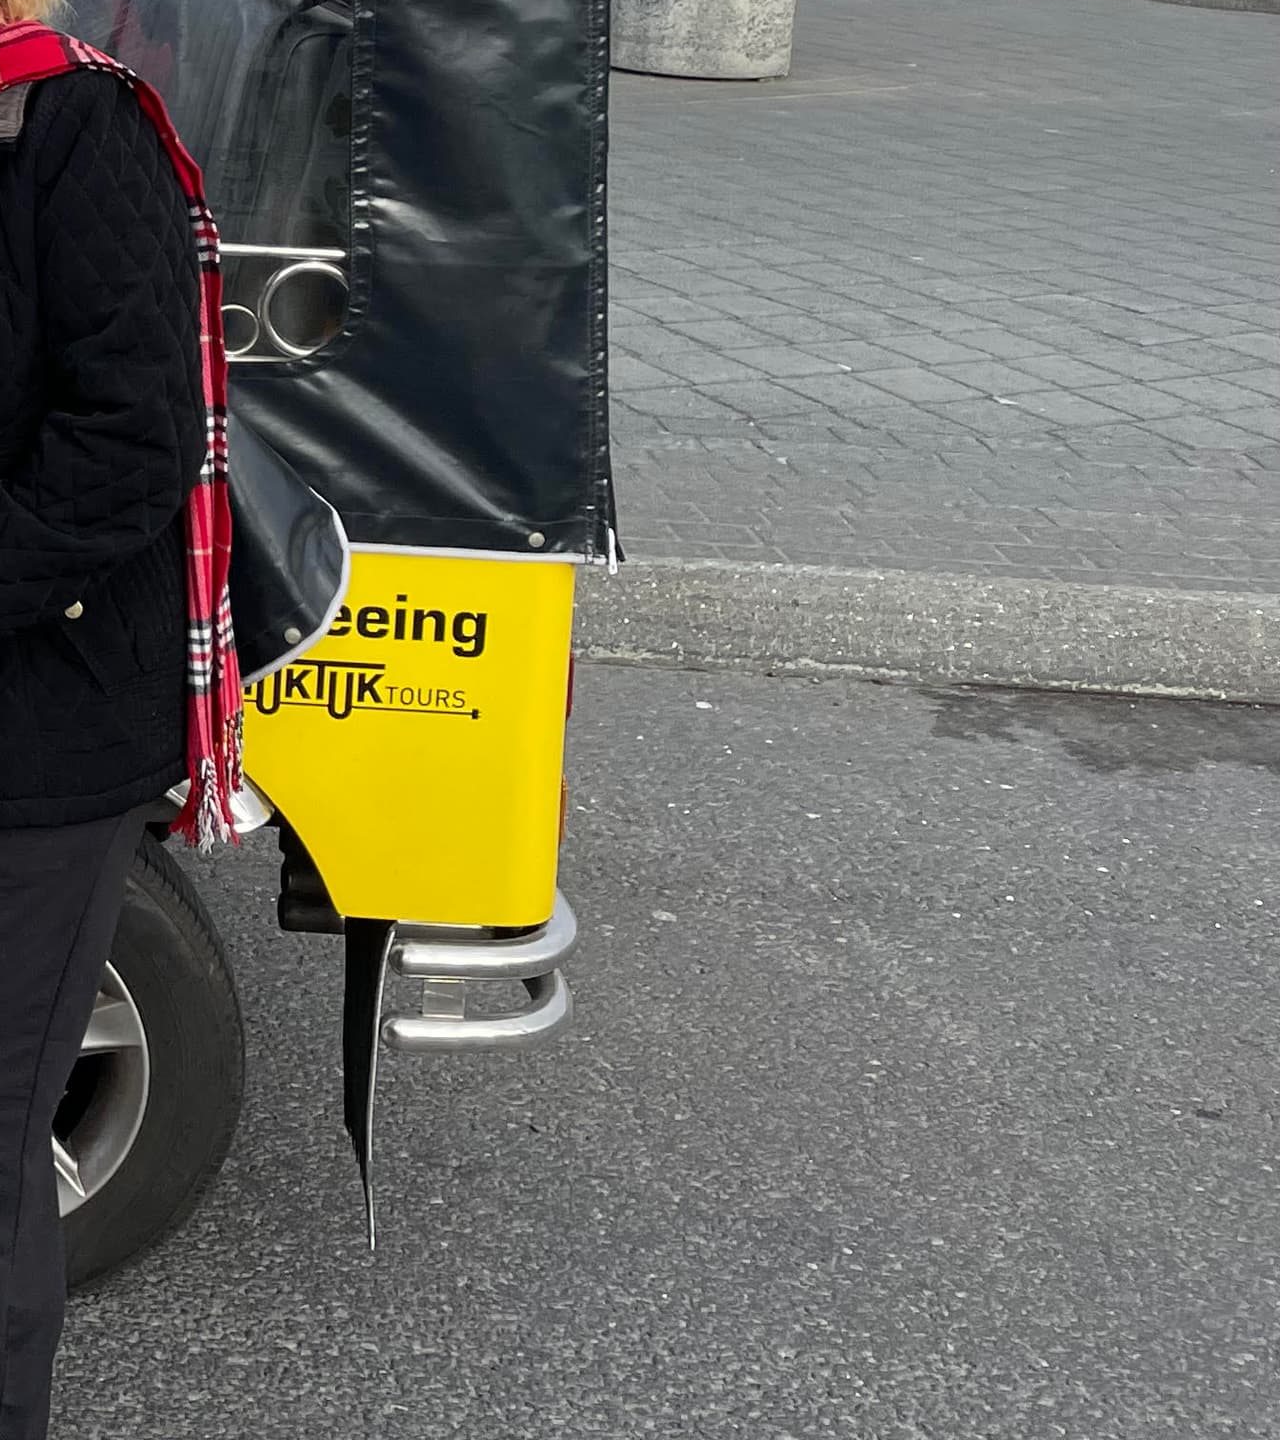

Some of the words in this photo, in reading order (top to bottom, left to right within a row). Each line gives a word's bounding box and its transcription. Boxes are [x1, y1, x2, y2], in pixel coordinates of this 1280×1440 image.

[327, 594, 488, 658] eeing
[244, 659, 386, 719] UKTUK
[385, 686, 466, 709] TOURS
